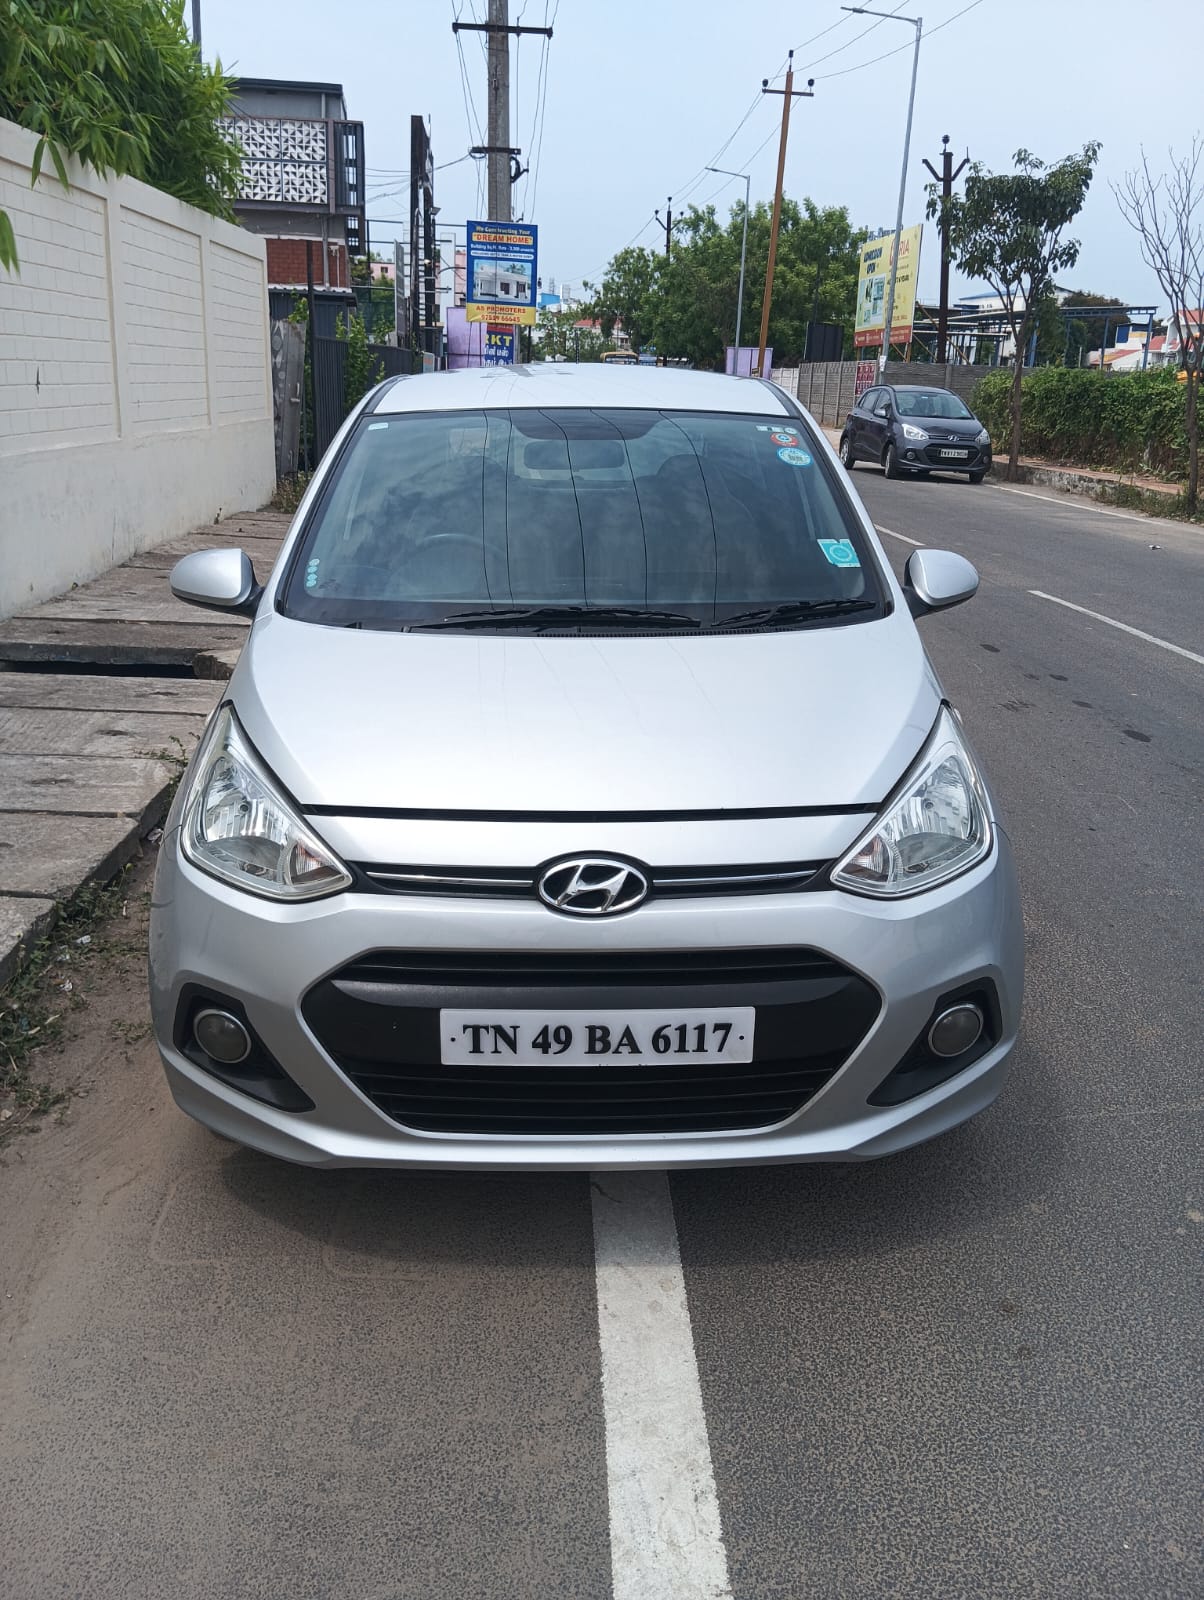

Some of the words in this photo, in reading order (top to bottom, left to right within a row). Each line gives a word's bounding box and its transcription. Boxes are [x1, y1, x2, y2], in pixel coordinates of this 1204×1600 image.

[462, 1023, 520, 1054] TN
[531, 1024, 573, 1055] 49
[584, 1024, 642, 1055] BA
[652, 1022, 733, 1054] 6117
